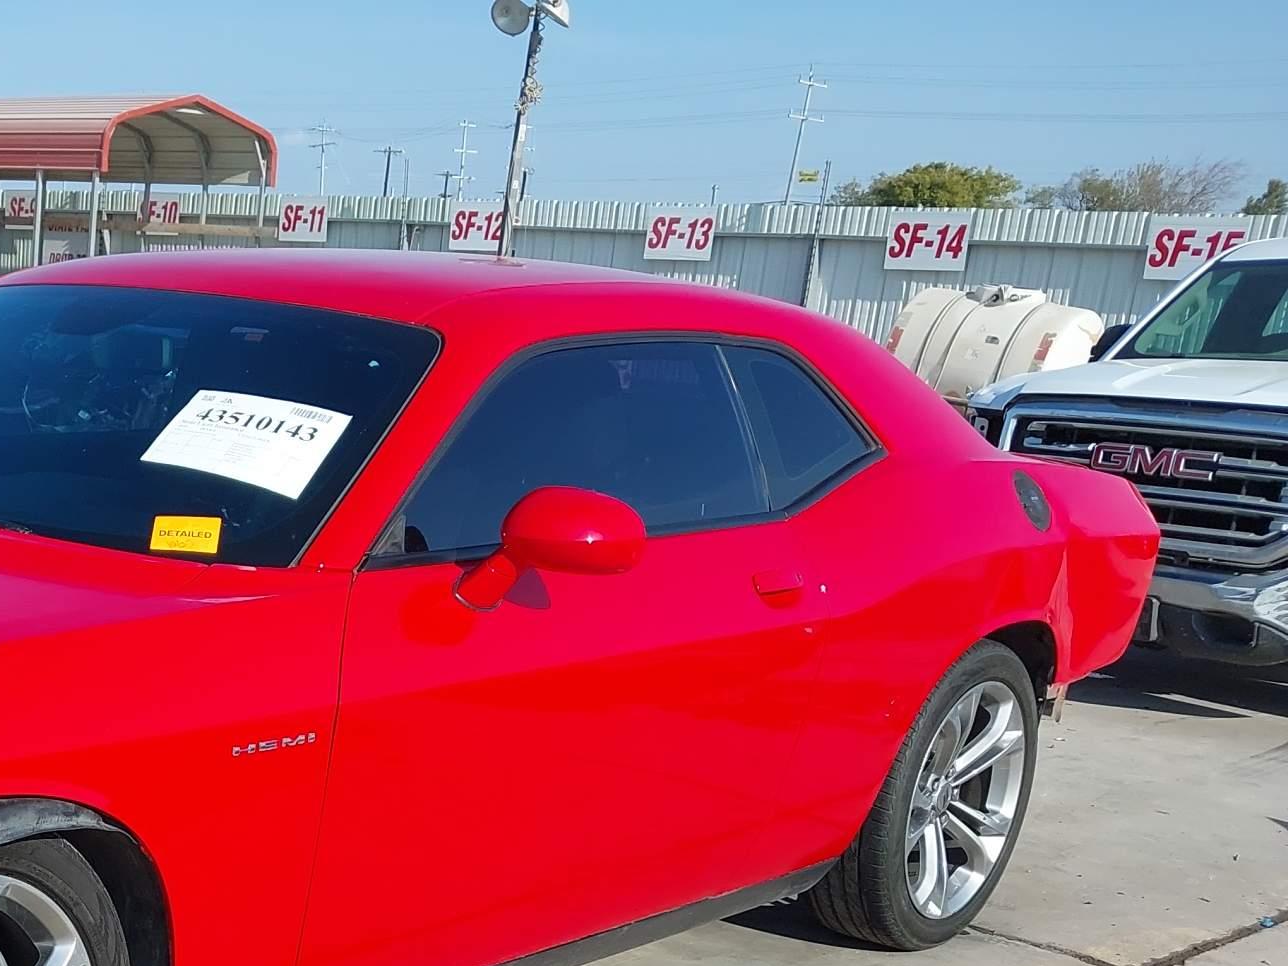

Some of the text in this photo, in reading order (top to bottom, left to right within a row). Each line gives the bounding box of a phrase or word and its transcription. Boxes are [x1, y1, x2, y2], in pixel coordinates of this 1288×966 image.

[282, 204, 326, 232] SF-11
[451, 210, 504, 241] SF-12
[647, 216, 713, 250] SF-13
[888, 222, 968, 259] SF-14
[196, 407, 318, 441] 43510143
[1091, 442, 1221, 481] GMC
[159, 529, 212, 539] DETAILED
[232, 732, 316, 757] HEMI
